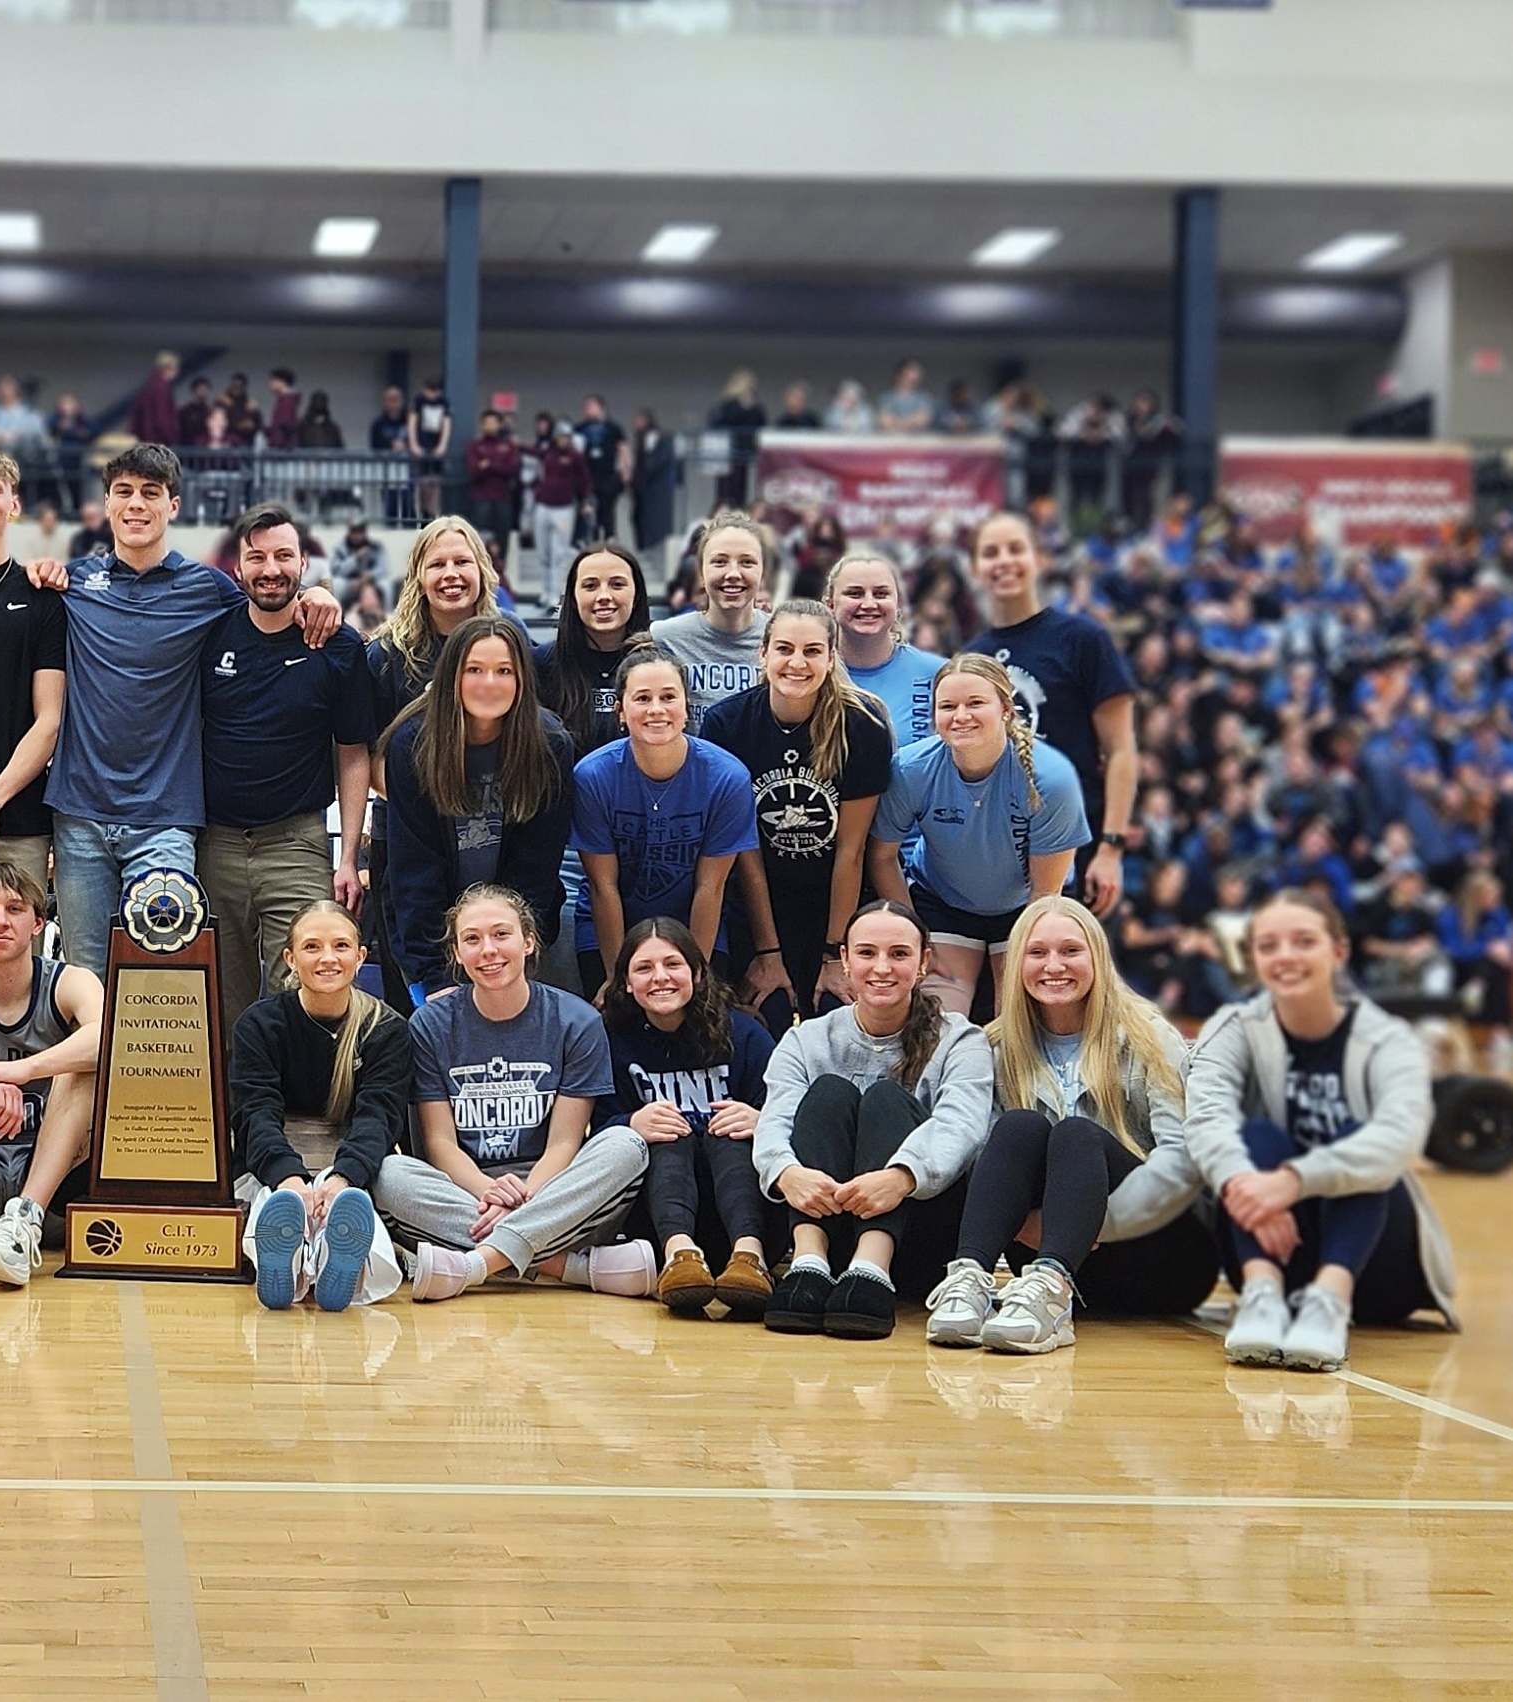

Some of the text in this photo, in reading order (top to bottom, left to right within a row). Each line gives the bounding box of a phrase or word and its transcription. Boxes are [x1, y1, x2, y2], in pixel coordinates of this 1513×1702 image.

[220, 651, 235, 668] C
[752, 767, 794, 795] NCORDIA
[124, 994, 198, 1006] CONCORDIA
[120, 1018, 202, 1030] INVITATIONAL
[127, 1043, 195, 1054] BASKETBALL
[119, 1066, 202, 1078] TOURNAMENT
[628, 1062, 730, 1114] CUNE
[162, 1224, 196, 1238] C.I.T.
[144, 1242, 218, 1257] Since 1973
